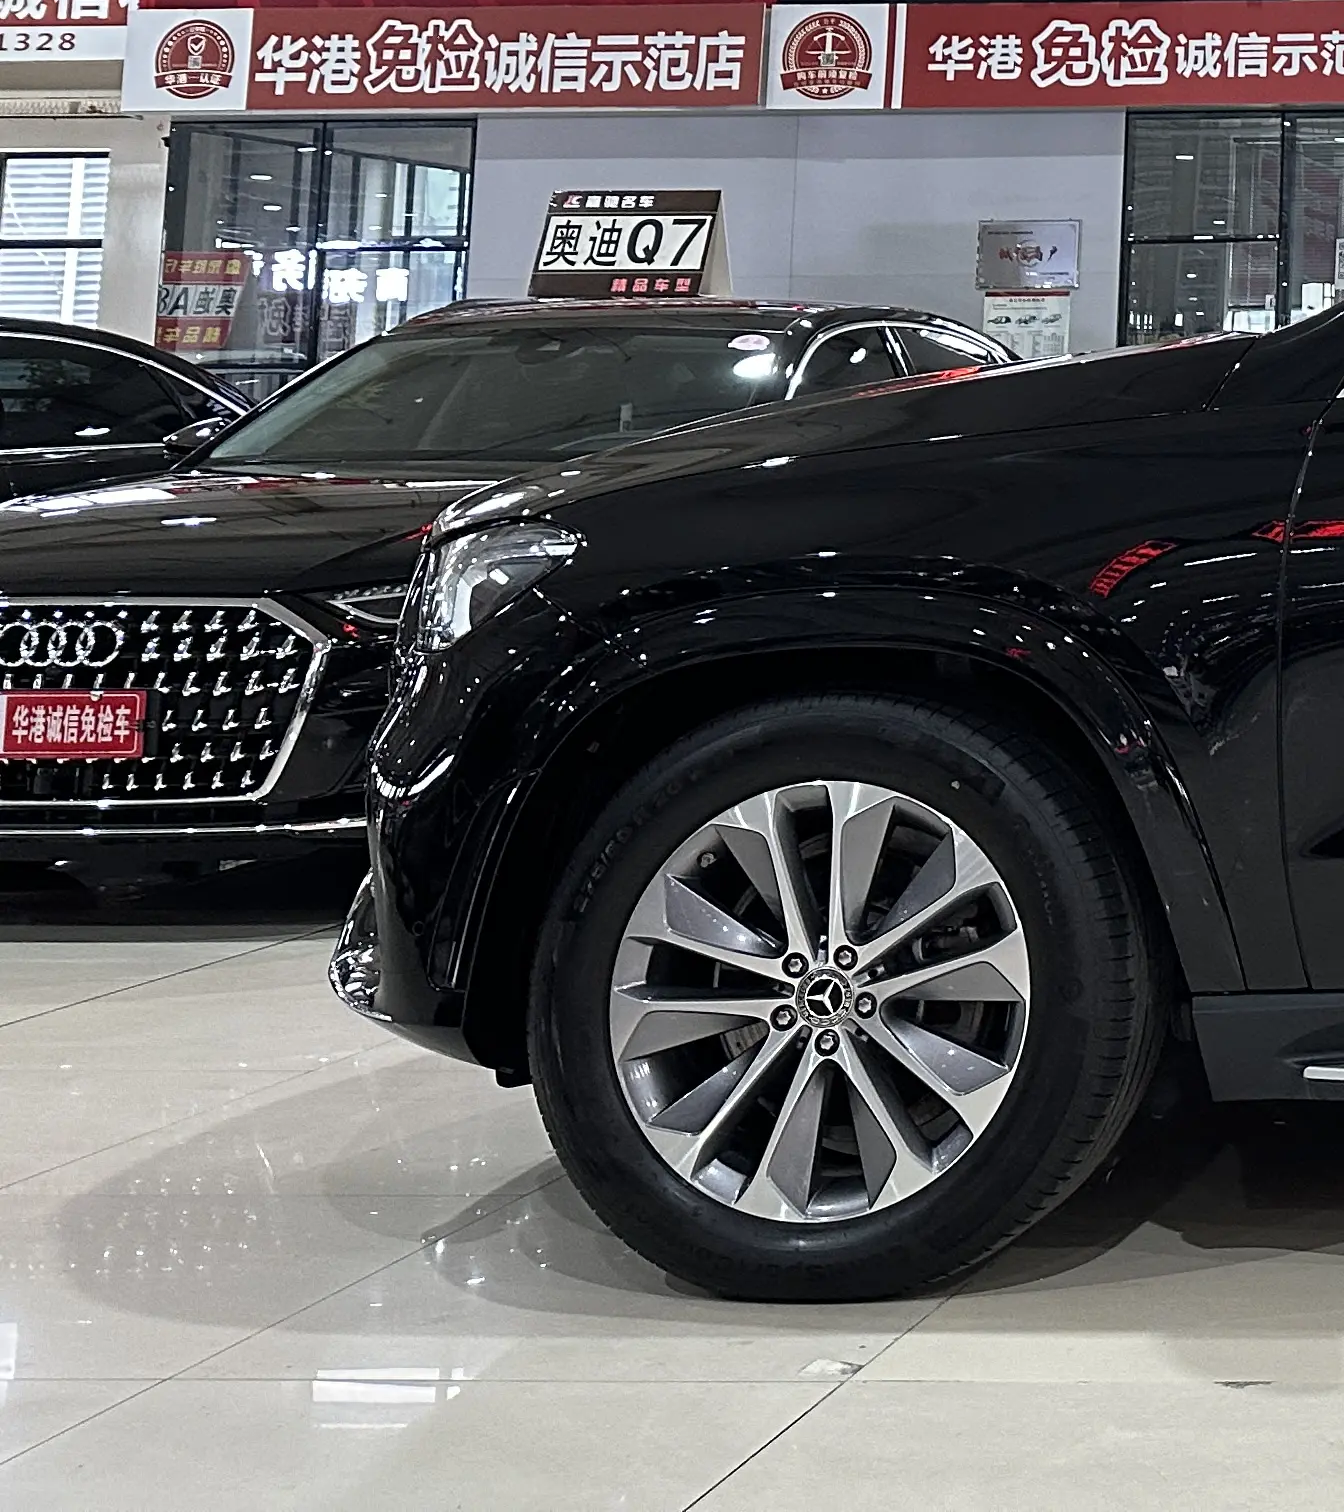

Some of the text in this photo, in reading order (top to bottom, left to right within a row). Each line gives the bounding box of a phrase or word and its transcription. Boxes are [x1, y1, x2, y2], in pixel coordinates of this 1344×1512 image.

[255, 18, 746, 95] 华港免检诚信示范店
[542, 218, 708, 267] 奥迪Q7
[11, 703, 132, 745] 华港诚信免检车
